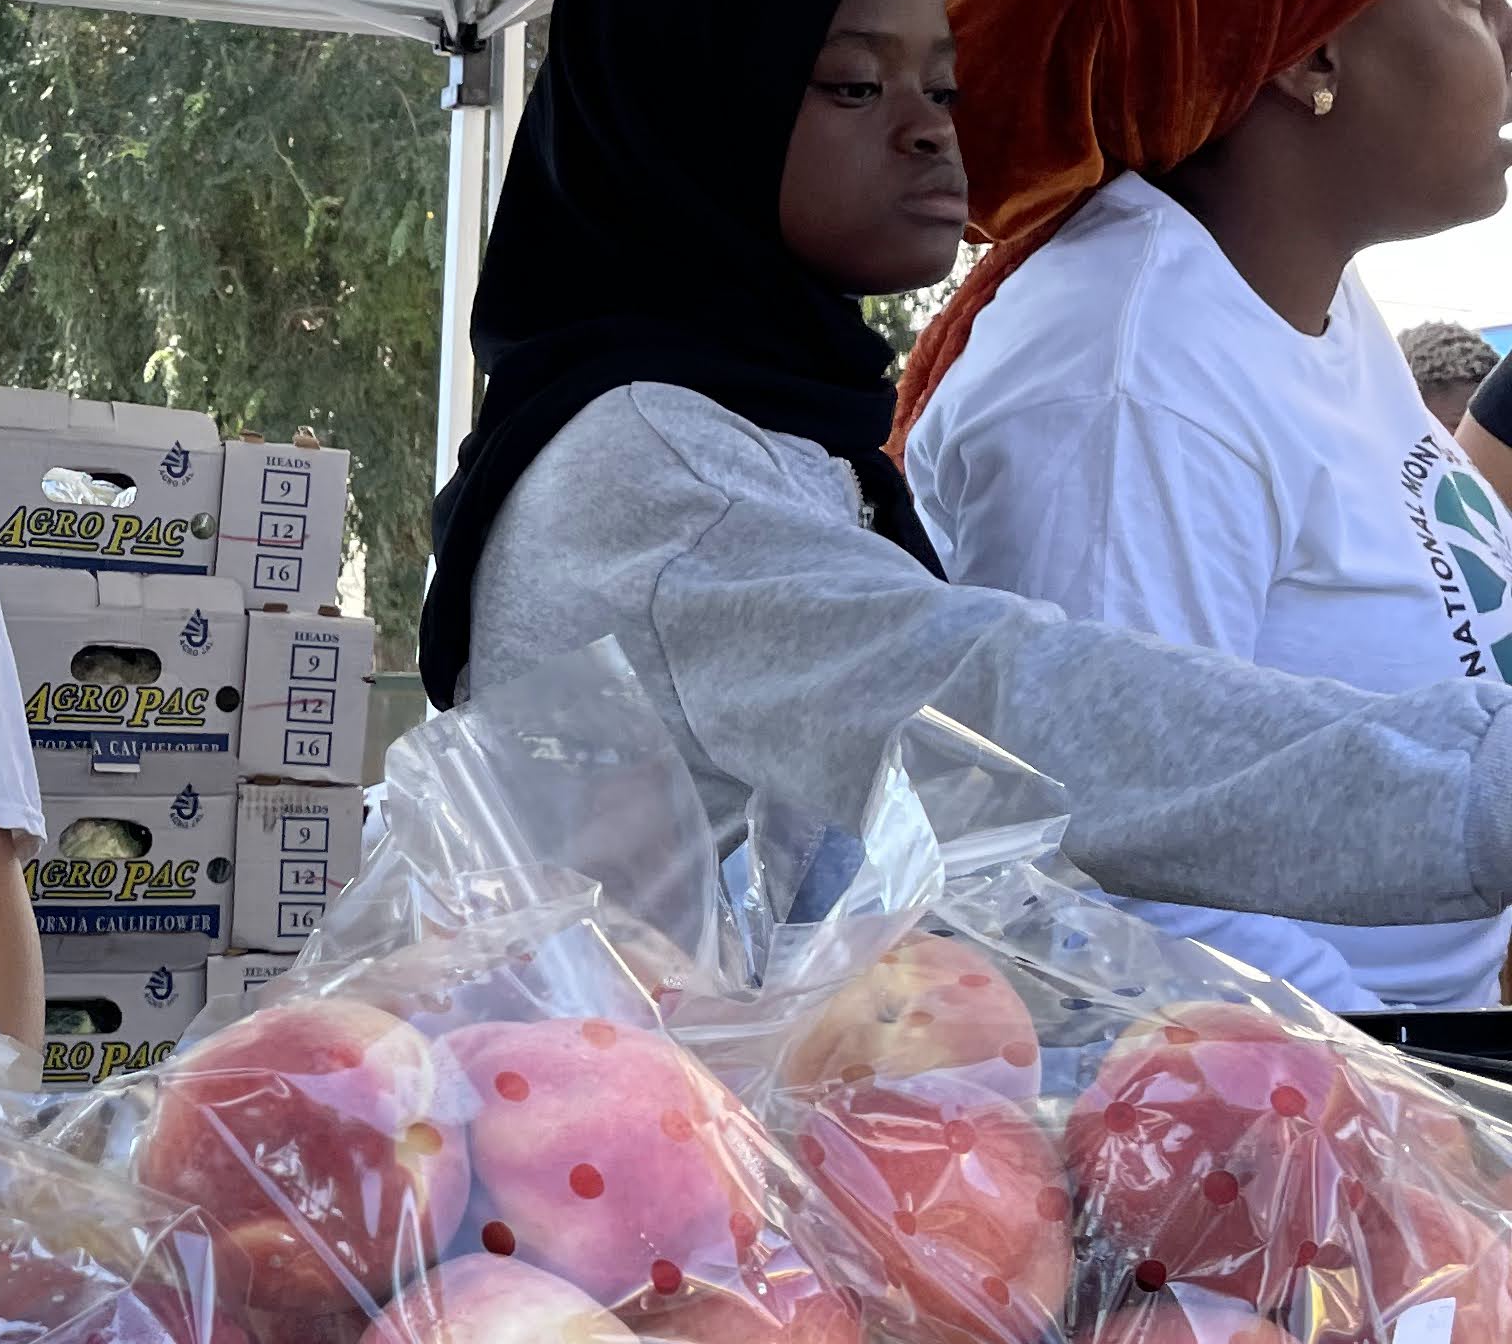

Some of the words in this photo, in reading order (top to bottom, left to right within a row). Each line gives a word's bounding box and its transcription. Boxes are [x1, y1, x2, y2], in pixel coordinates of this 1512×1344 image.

[266, 456, 311, 469] HEADS
[280, 480, 292, 498] 9
[101, 513, 189, 555] PAC
[271, 523, 294, 539] 12
[266, 564, 291, 582] 16
[1404, 499, 1487, 678] NATIONAL
[294, 631, 340, 643] HEADS
[308, 655, 320, 673] 9
[26, 682, 129, 725] AGRO
[126, 686, 209, 728] PAC
[298, 698, 324, 714] 12
[296, 739, 320, 757] 16
[299, 826, 311, 844] 9
[115, 859, 199, 901] PAC
[292, 869, 316, 885] 12
[290, 909, 315, 928] 16
[44, 1041, 94, 1070] RO
